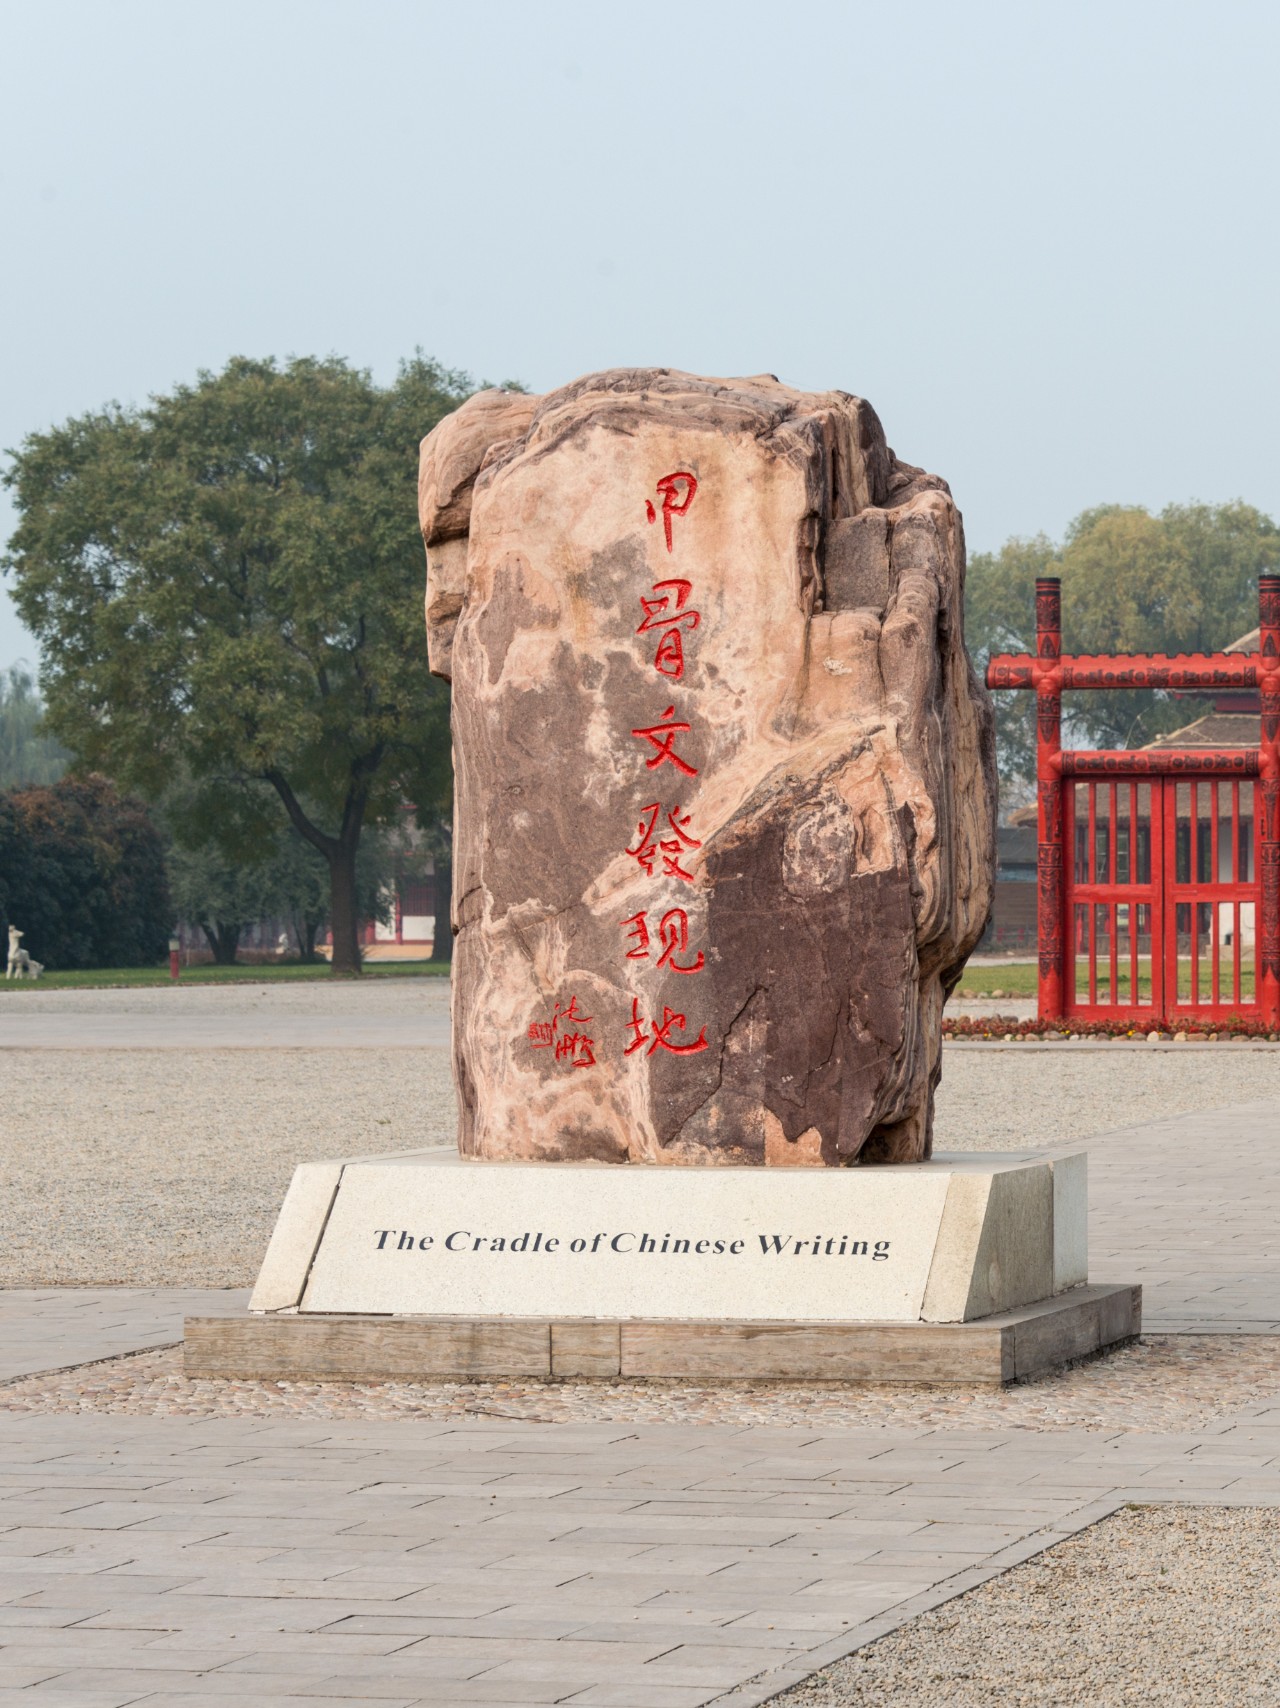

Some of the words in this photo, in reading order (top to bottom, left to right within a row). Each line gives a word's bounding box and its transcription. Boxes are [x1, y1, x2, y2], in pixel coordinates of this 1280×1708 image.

[374, 1229, 435, 1251] The
[444, 1230, 561, 1254] Cradle
[570, 1232, 608, 1254] of
[610, 1232, 746, 1255] Chinese
[757, 1234, 893, 1262] Writing
